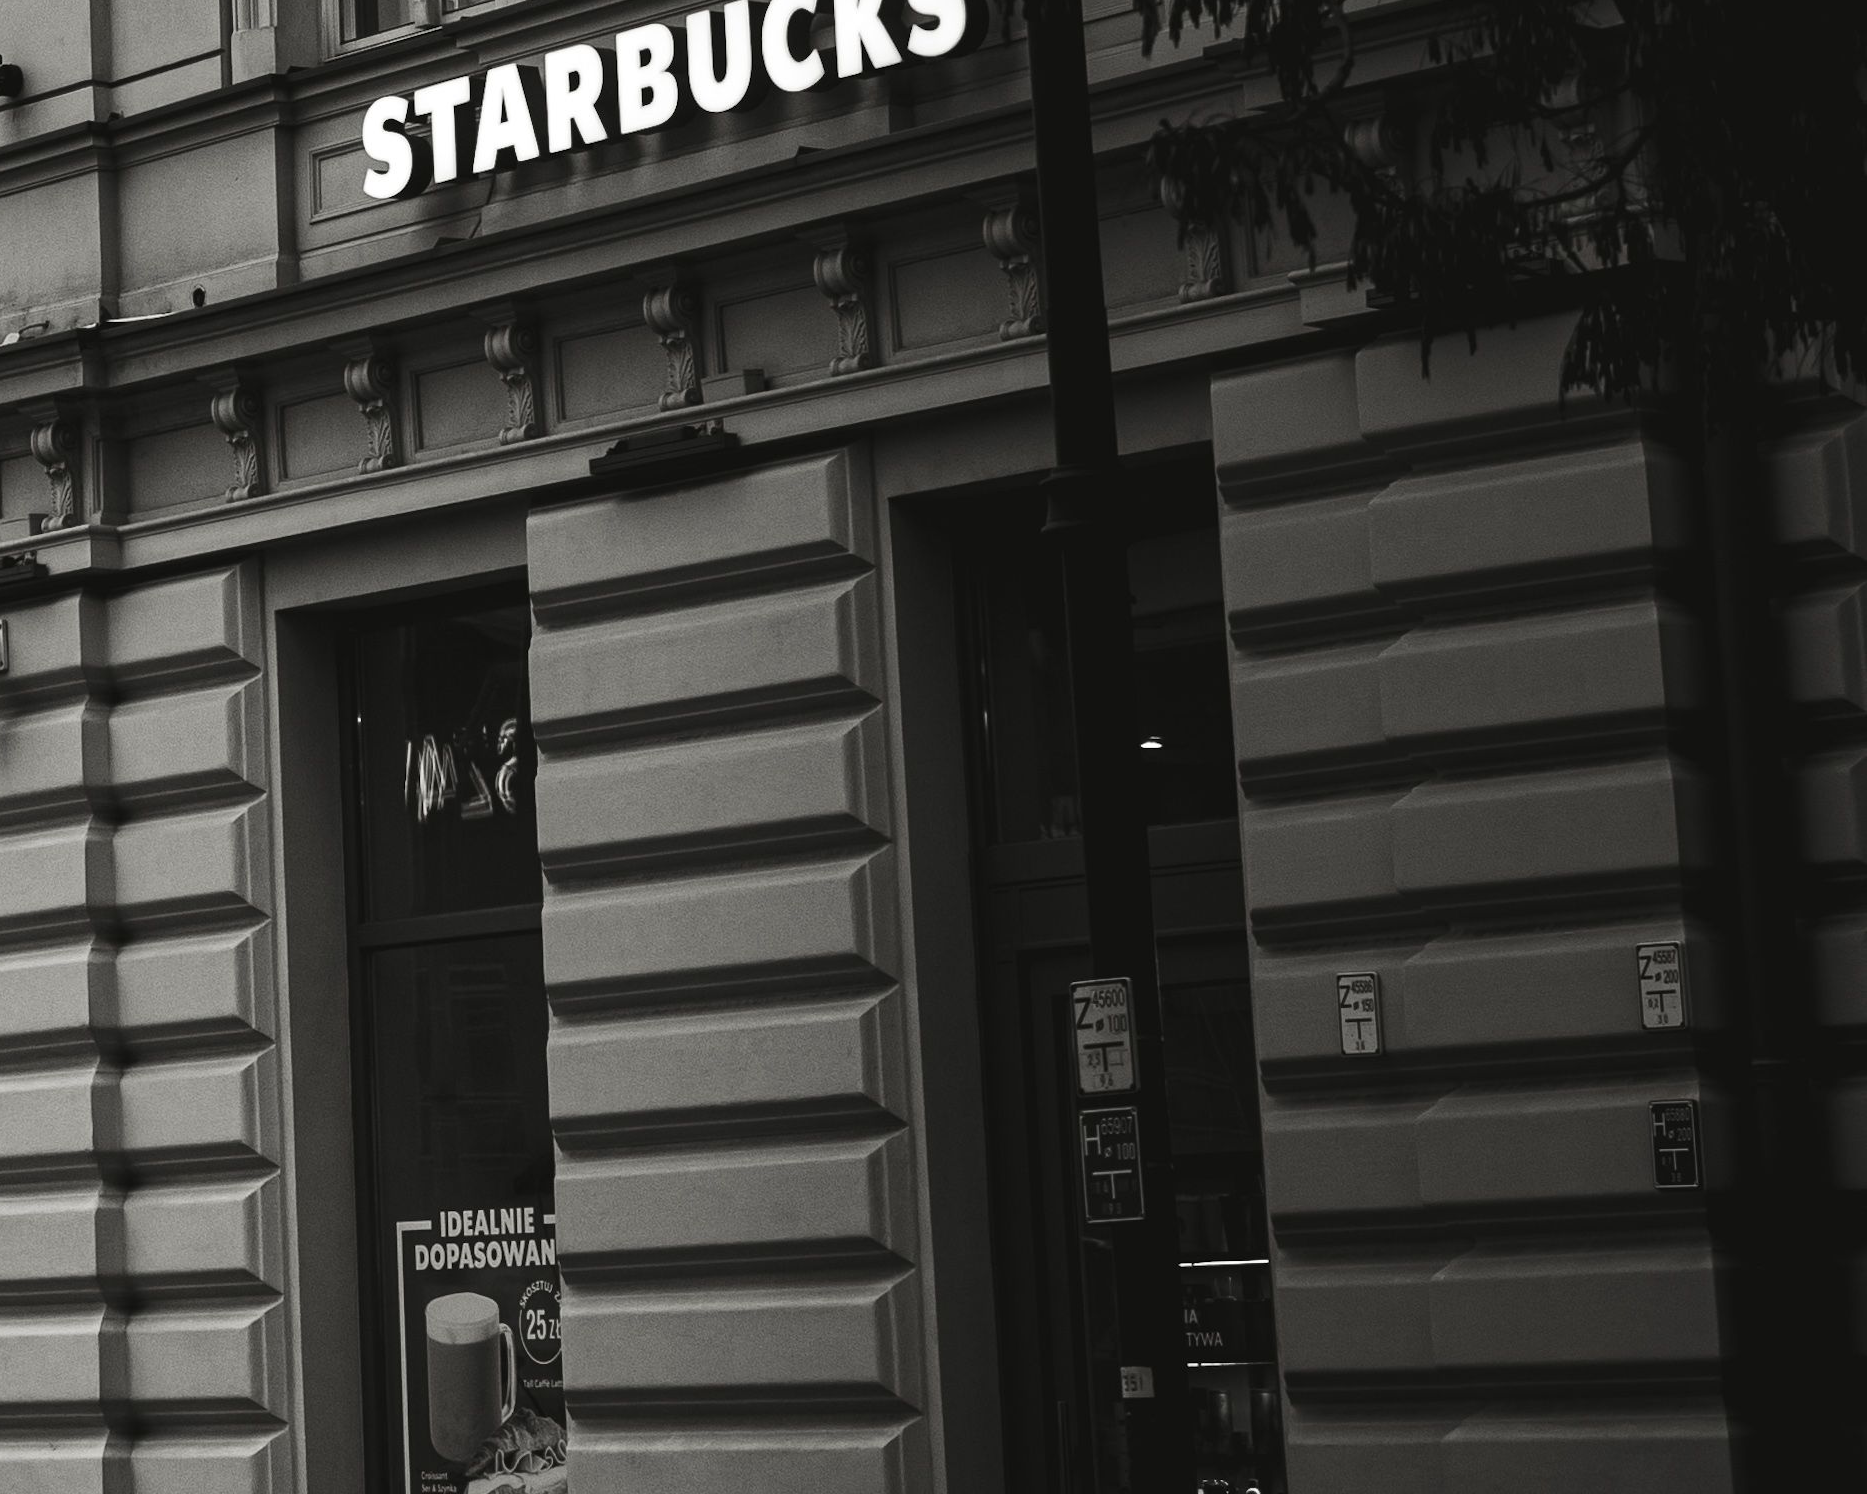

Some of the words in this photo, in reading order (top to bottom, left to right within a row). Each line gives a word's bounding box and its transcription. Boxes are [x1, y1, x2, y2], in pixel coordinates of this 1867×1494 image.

[1639, 955, 1654, 980] Z
[1663, 970, 1679, 985] 200
[1092, 989, 1126, 1008] 45600
[1339, 985, 1352, 1009] Z
[1074, 997, 1094, 1030] Z
[1107, 1015, 1128, 1032] 100
[1652, 1112, 1667, 1137] H
[1083, 1124, 1101, 1156] H
[1116, 1142, 1136, 1160] 100
[439, 1207, 535, 1238] IDEALNIE
[519, 1280, 554, 1310] SKOSZTUJ
[526, 1309, 547, 1340] 25
[1186, 1332, 1224, 1347] TYWA
